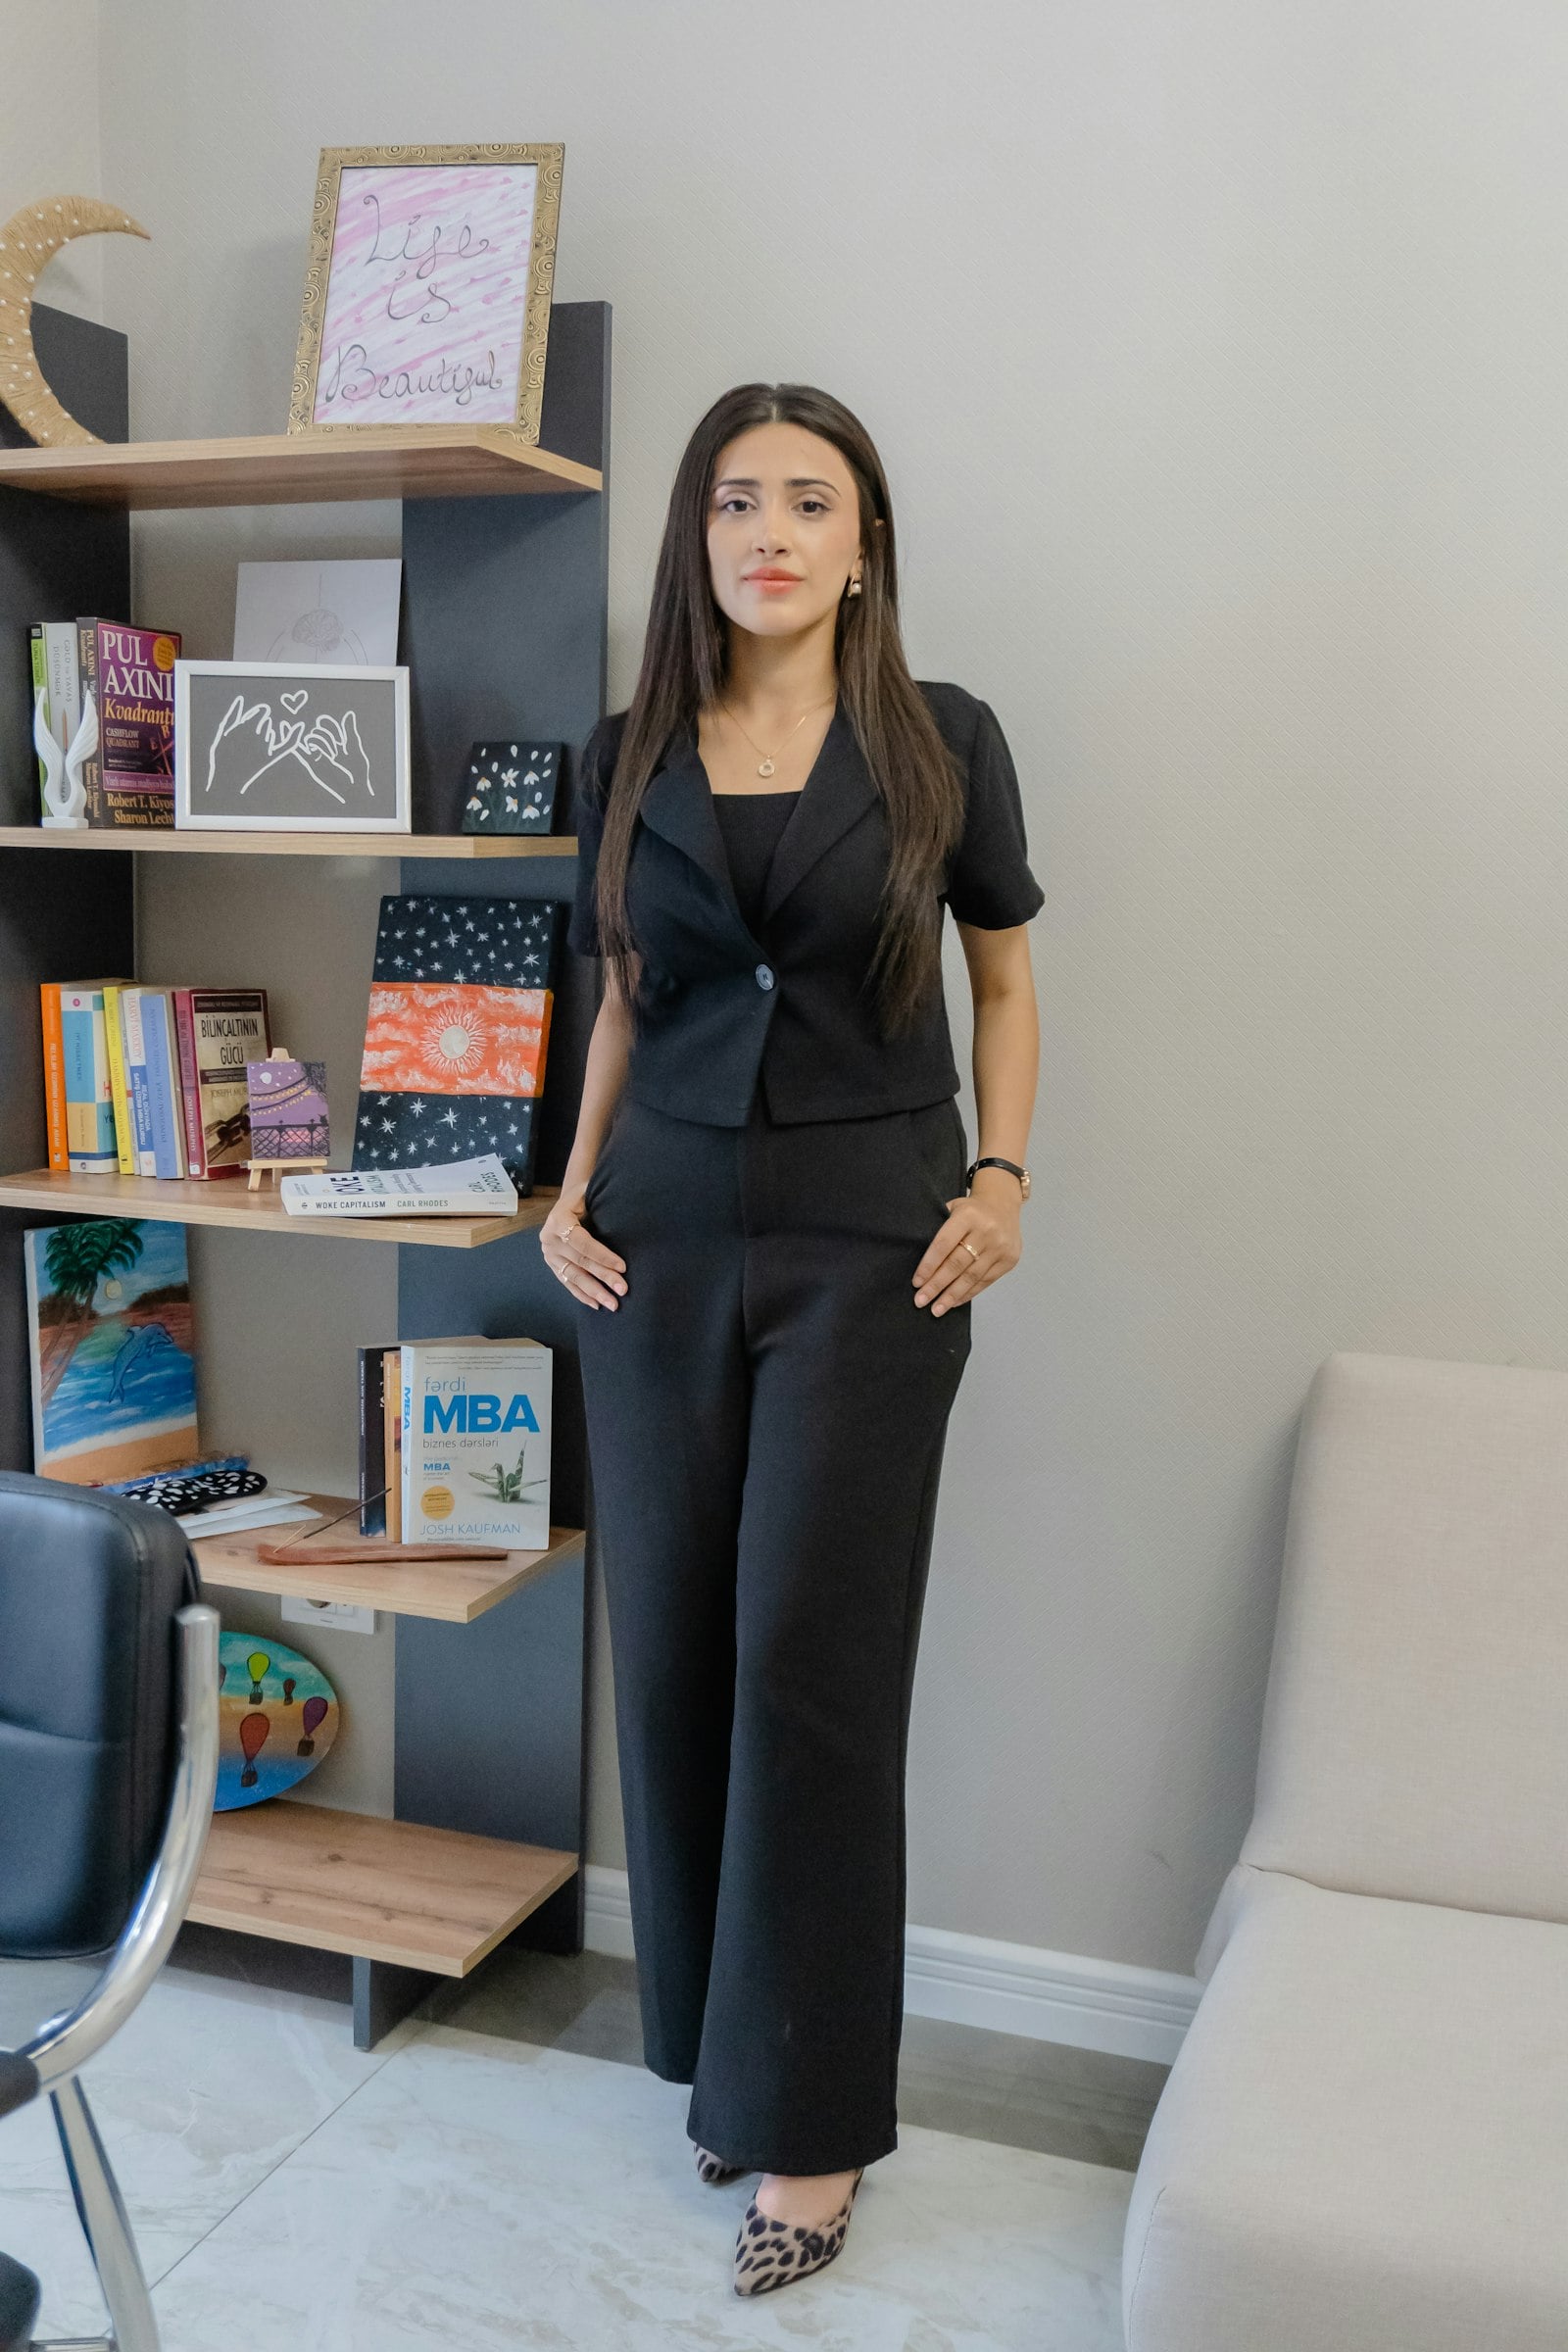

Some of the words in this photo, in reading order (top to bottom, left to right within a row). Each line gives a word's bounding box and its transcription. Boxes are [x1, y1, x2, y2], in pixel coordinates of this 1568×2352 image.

[363, 195, 489, 279] Life
[325, 344, 503, 406] Beautiful
[102, 630, 147, 666] PUL
[104, 664, 173, 702] AXINI
[106, 727, 139, 738] CASHFLOW
[106, 737, 139, 748] QUADRANT
[107, 793, 136, 808] Robert
[137, 795, 148, 808] T.
[148, 795, 174, 811] Kiyos
[115, 809, 148, 824] Sharon
[149, 811, 174, 824] Lech
[220, 1043, 243, 1065] GÜCÜ
[330, 1176, 366, 1196] OKE
[340, 1200, 386, 1209] CAPITALISM
[424, 1376, 466, 1393] fərdi
[423, 1394, 541, 1434] MBA
[422, 1439, 457, 1448] biznes
[460, 1437, 499, 1448] dərsləri
[420, 1524, 454, 1536] JOSH
[458, 1523, 521, 1535] KAUFMAN
